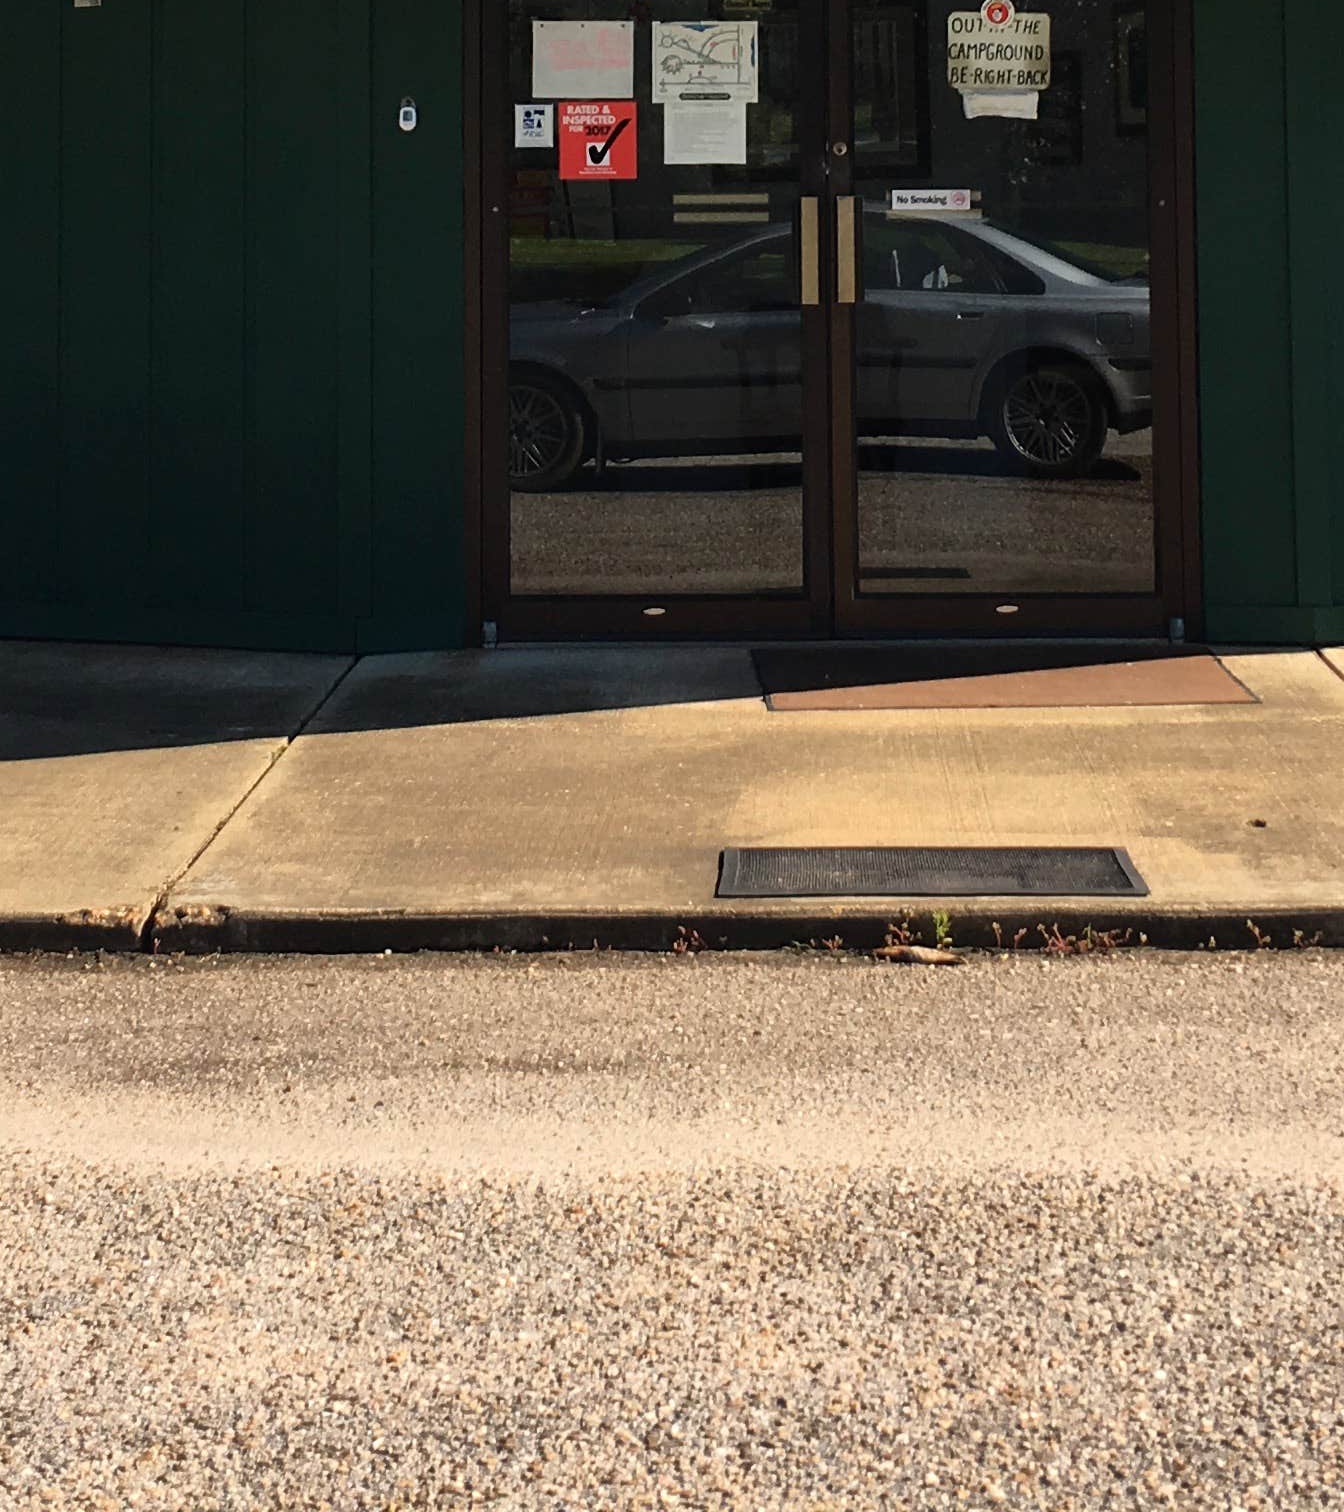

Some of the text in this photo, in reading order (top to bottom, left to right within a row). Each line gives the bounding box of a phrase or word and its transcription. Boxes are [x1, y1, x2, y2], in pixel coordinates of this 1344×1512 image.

[948, 42, 1044, 61] CAMPGROUND
[567, 104, 611, 115] RATED &
[562, 115, 616, 125] INSPECTED
[896, 193, 948, 206] No Smoking
